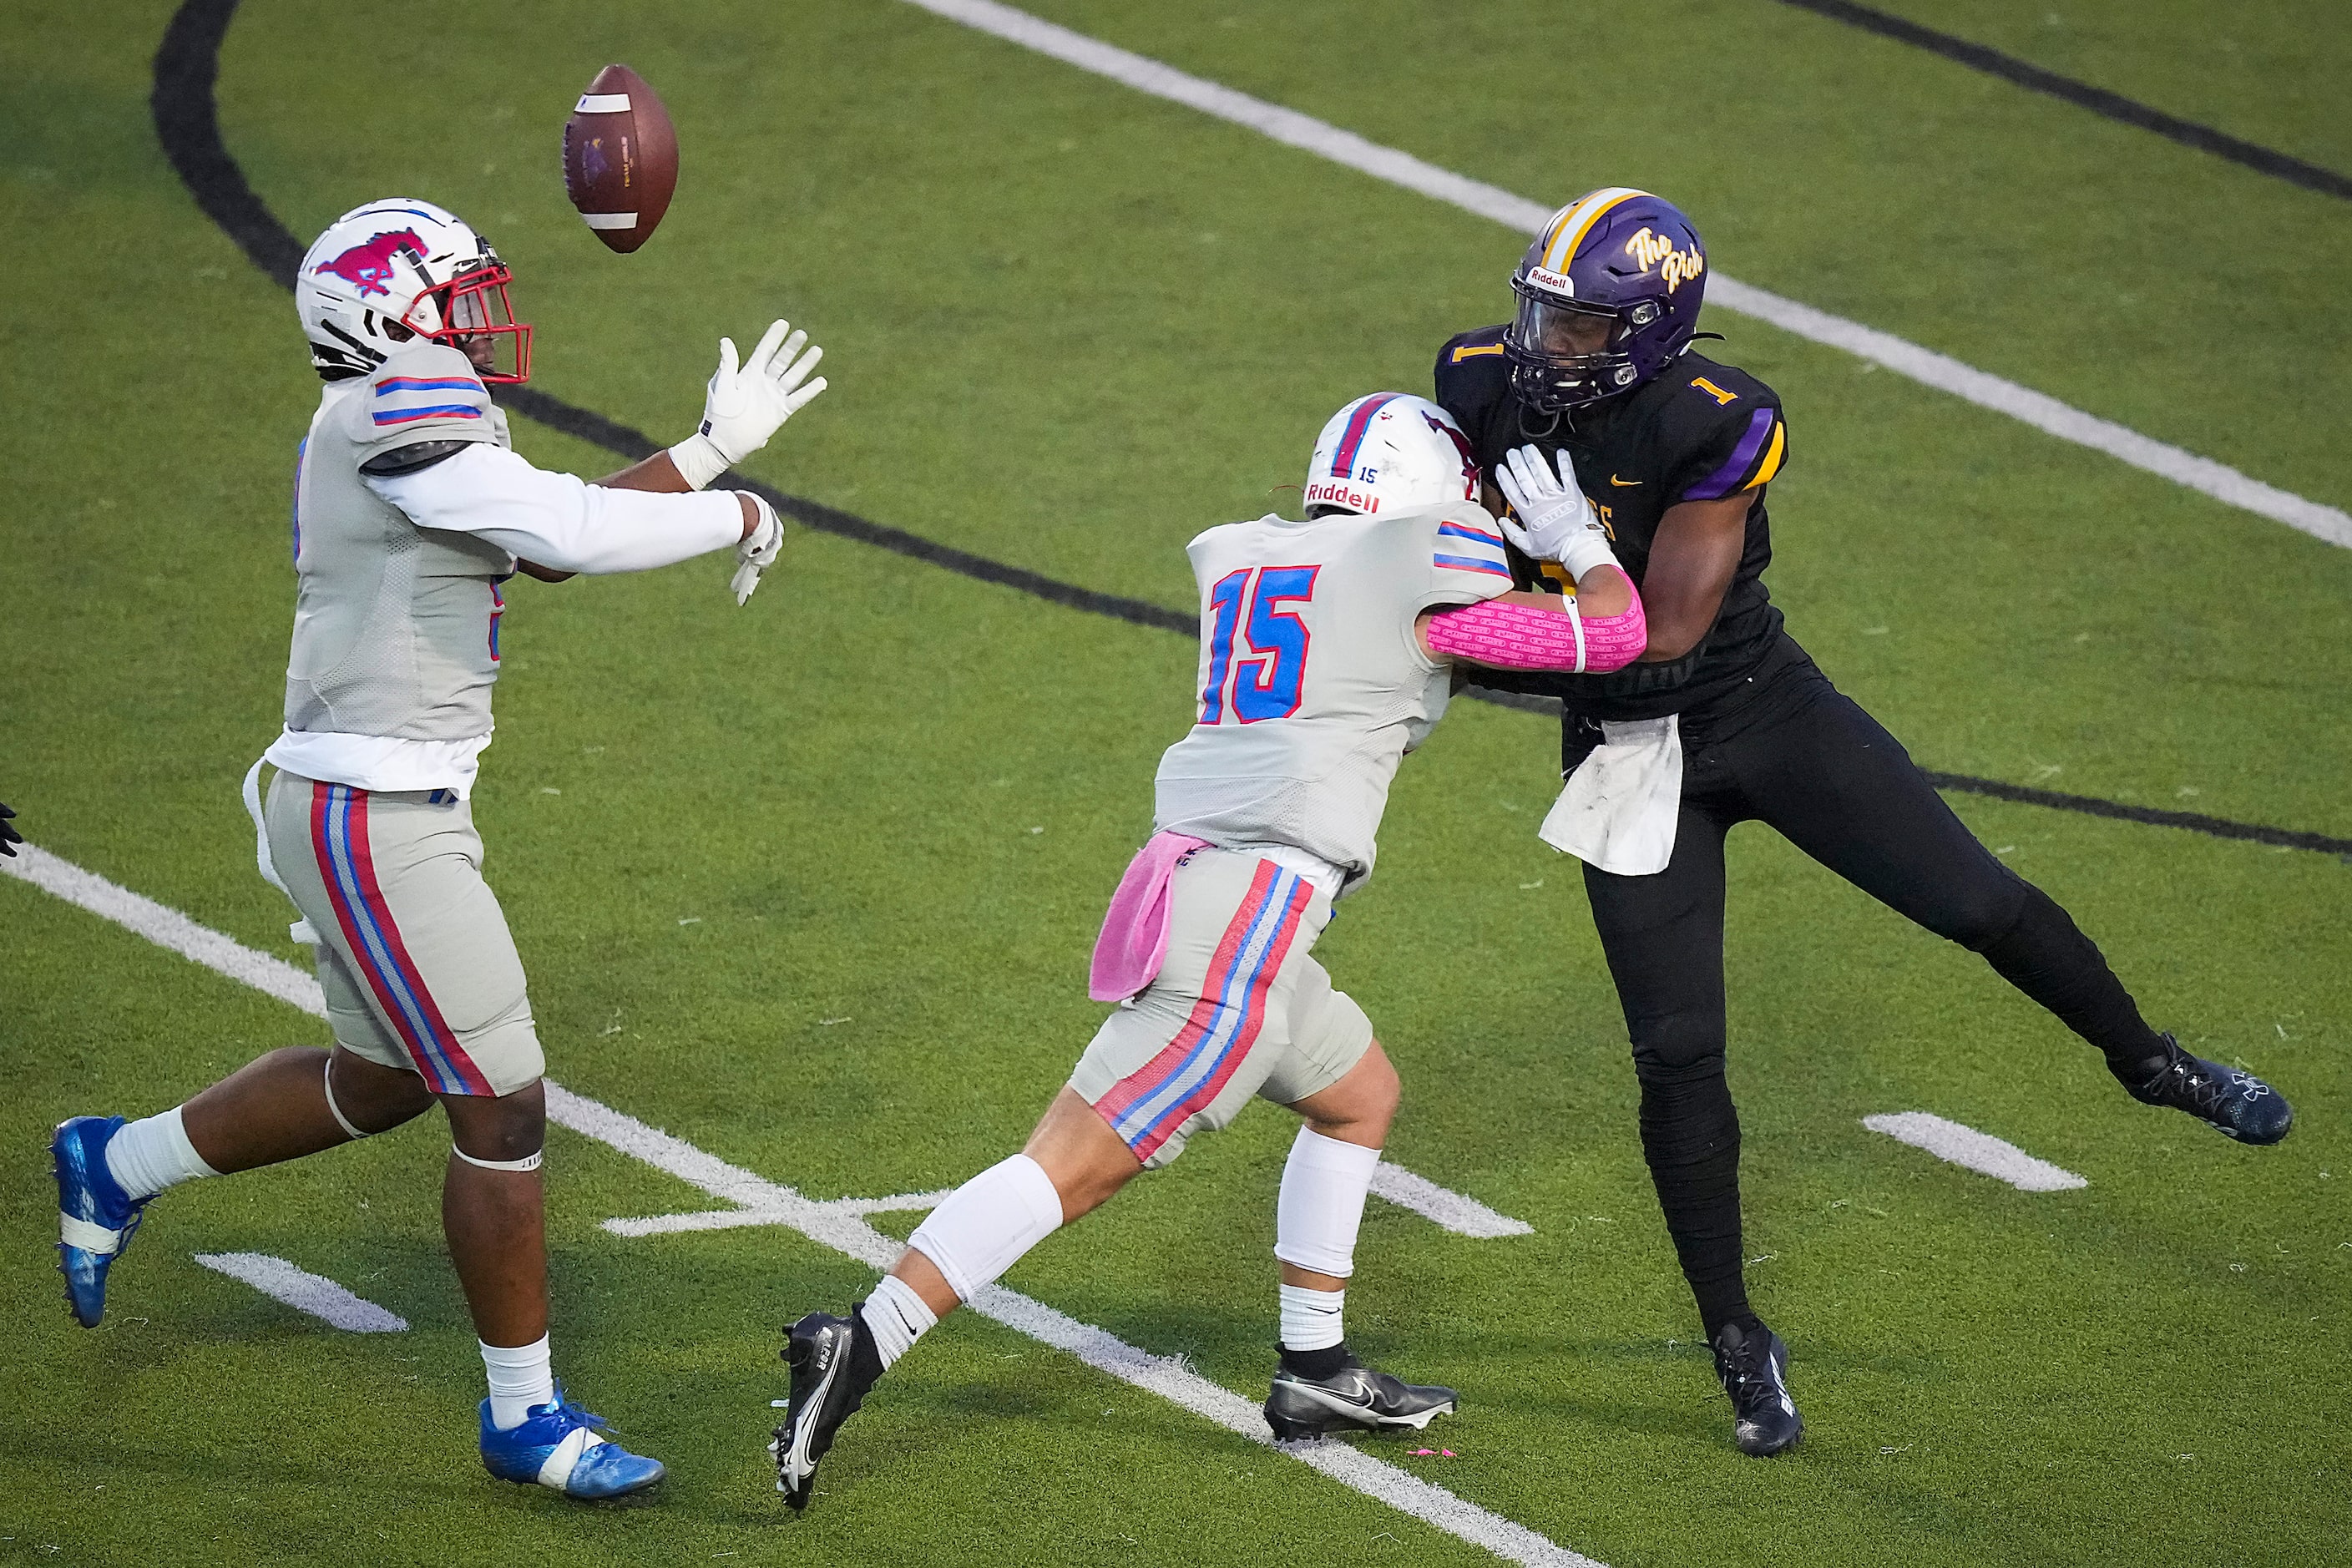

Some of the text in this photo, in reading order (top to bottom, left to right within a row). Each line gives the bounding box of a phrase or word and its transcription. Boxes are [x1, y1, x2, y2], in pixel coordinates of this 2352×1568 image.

[1625, 226, 1672, 273] The
[1531, 270, 1566, 289] Riddell
[1661, 242, 1703, 294] Rich
[1449, 342, 1505, 364] 1
[1689, 376, 1739, 407] 1
[1359, 466, 1378, 484] 15
[1308, 483, 1379, 513] Riddell
[1198, 564, 1323, 726] 15
